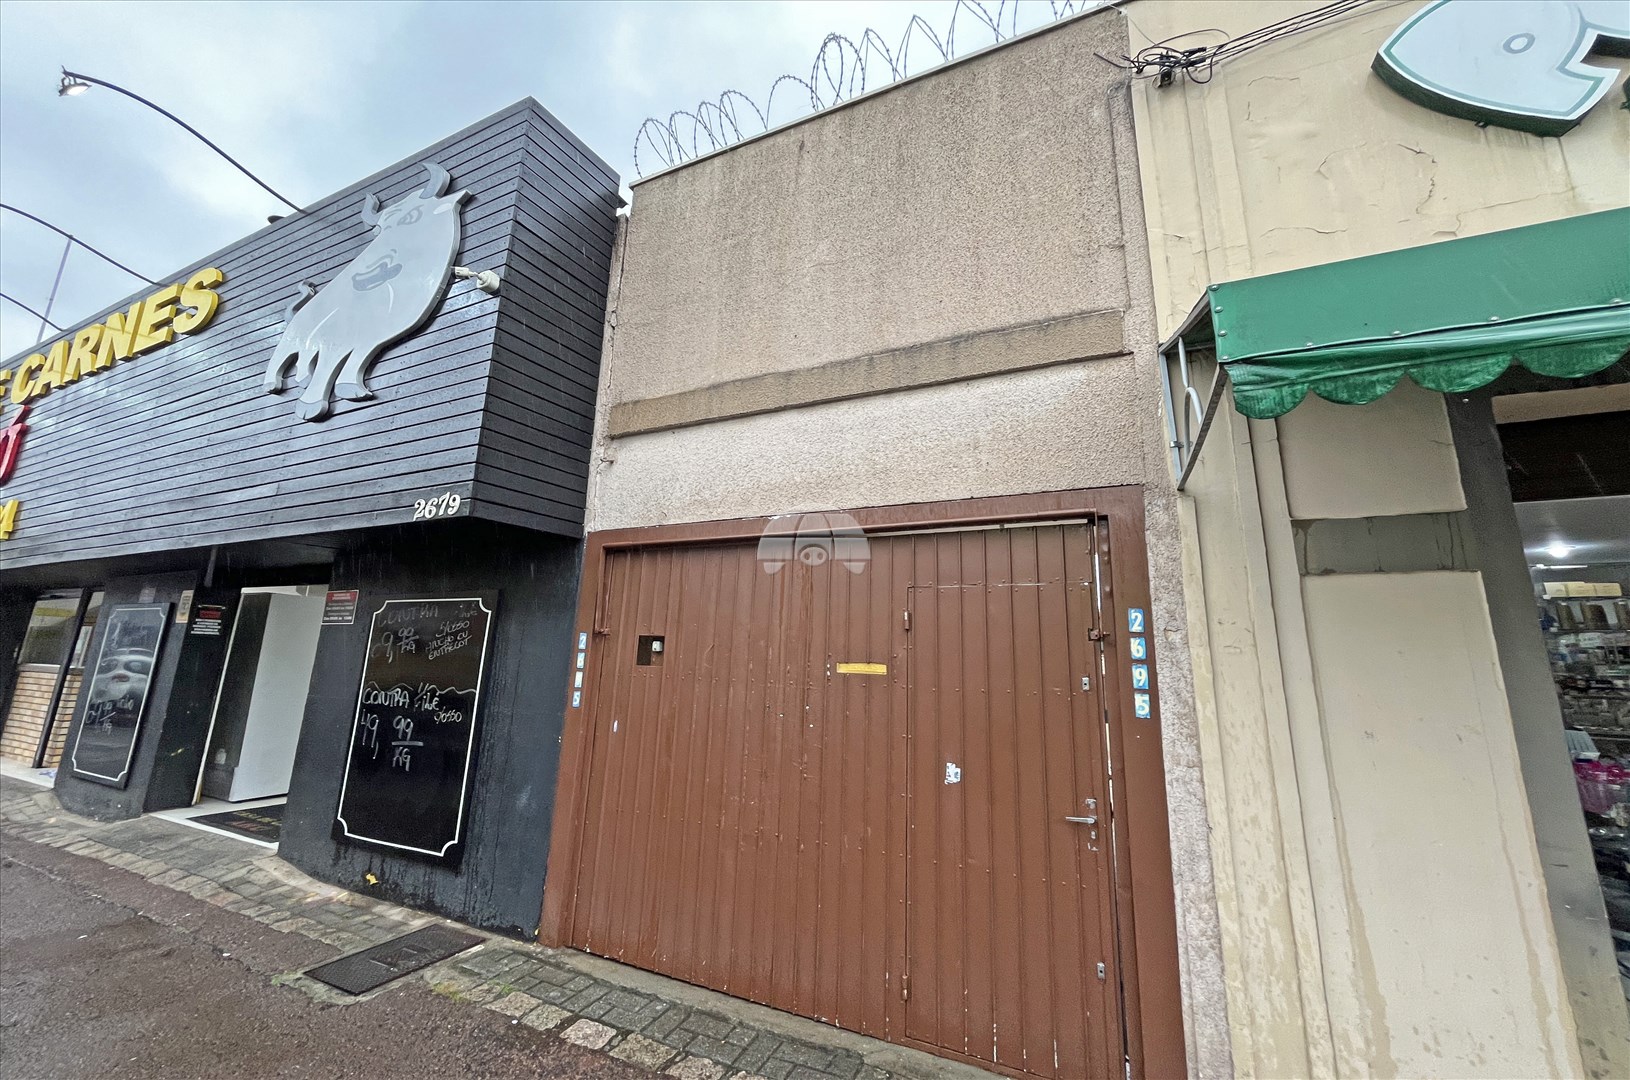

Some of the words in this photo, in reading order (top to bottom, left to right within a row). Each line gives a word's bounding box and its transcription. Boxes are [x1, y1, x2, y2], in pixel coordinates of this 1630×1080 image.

[11, 267, 223, 404] CARNES
[412, 491, 461, 521] 2679
[1129, 611, 1150, 715] 2695
[362, 687, 409, 709] CONTRA
